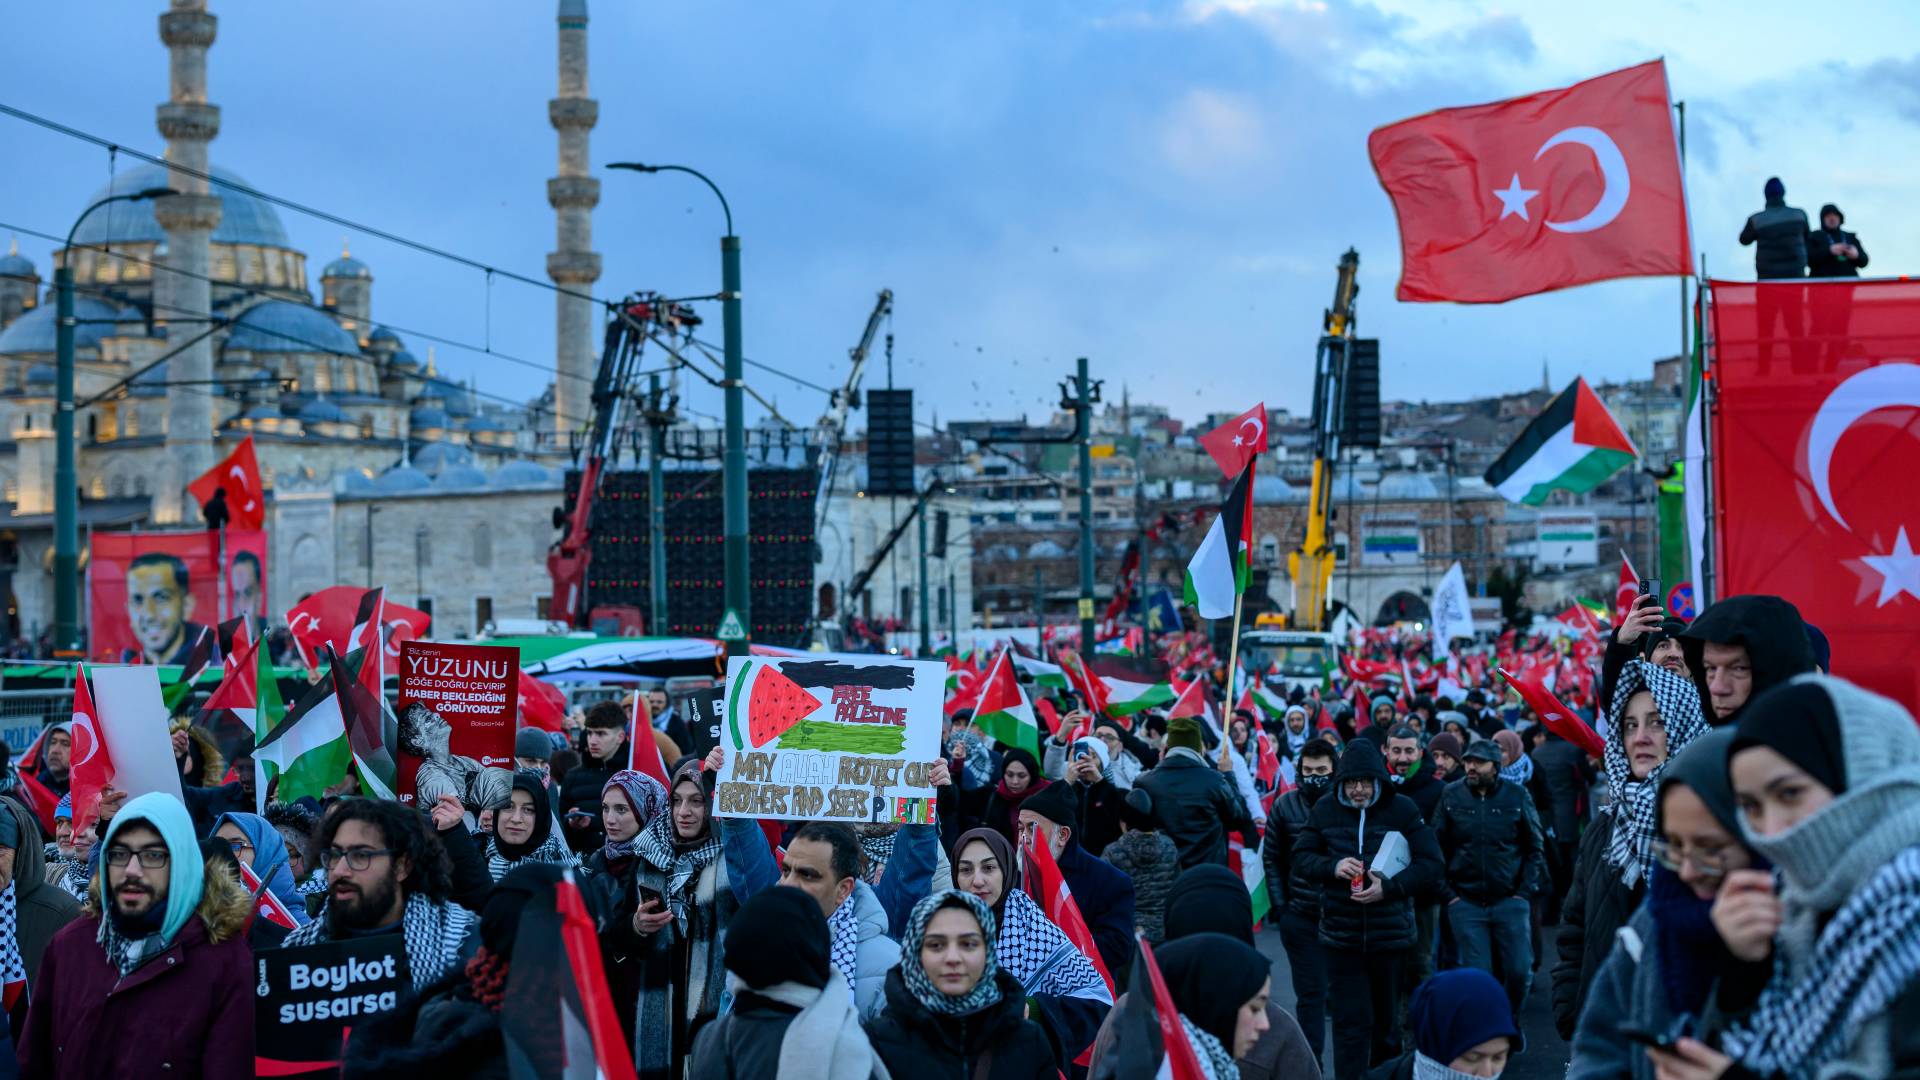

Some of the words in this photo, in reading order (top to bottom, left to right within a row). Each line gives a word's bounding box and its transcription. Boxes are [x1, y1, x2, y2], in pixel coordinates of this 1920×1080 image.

[725, 624, 740, 635] 20
[407, 656, 508, 679] YÜZÜNÜ
[405, 688, 440, 700] HABER
[441, 691, 506, 703] BEKLEDİĞİNİ
[406, 676, 433, 687] GÖĞE
[434, 679, 469, 689] DOĞRU
[470, 681, 506, 691] ÇEVİRİP
[831, 685, 873, 706] FREE
[834, 703, 907, 727] PALESTINE
[731, 751, 777, 783] MAY
[779, 752, 836, 785] ALLAH
[837, 756, 905, 787] PROTECT
[718, 781, 791, 814] BROTHERS
[791, 784, 825, 817] AND
[871, 796, 937, 825] PALESTINE
[290, 955, 396, 991] Boykot
[280, 991, 396, 1024] susarsa
